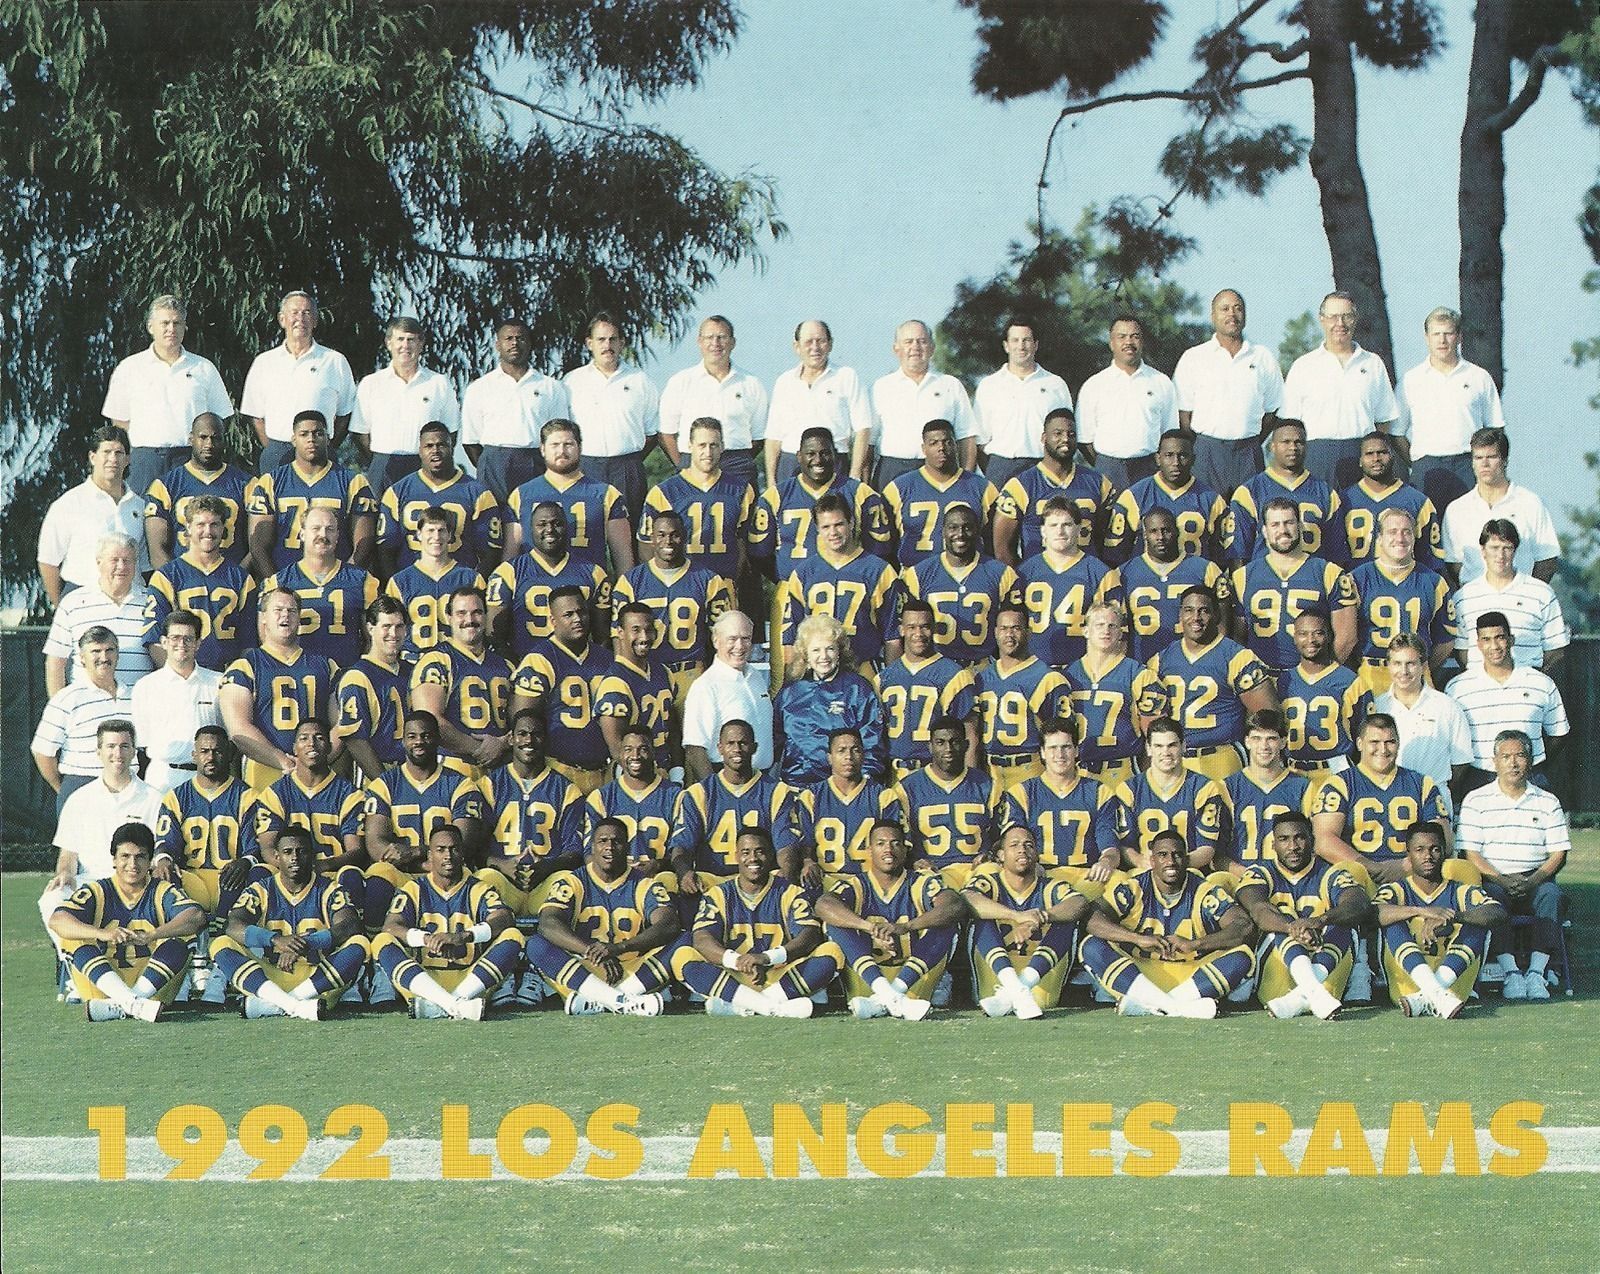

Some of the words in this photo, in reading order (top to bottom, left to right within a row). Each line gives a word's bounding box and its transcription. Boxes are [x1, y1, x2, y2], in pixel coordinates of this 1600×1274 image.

[686, 501, 726, 554] 11
[177, 587, 238, 640] 52
[296, 588, 346, 635] 51
[525, 585, 590, 637] 9
[927, 592, 992, 645] 53
[1025, 581, 1088, 636] 94
[1250, 589, 1320, 638] 95
[1370, 596, 1421, 648] 91
[272, 675, 316, 730] 61
[882, 685, 938, 741] 37
[1284, 695, 1339, 750] 83
[182, 816, 240, 869] 90
[494, 802, 556, 856] 43
[815, 817, 876, 872] 84
[918, 804, 985, 855] 55
[1037, 811, 1091, 865] 17
[1137, 809, 1188, 868] 81
[1352, 796, 1418, 853] 69
